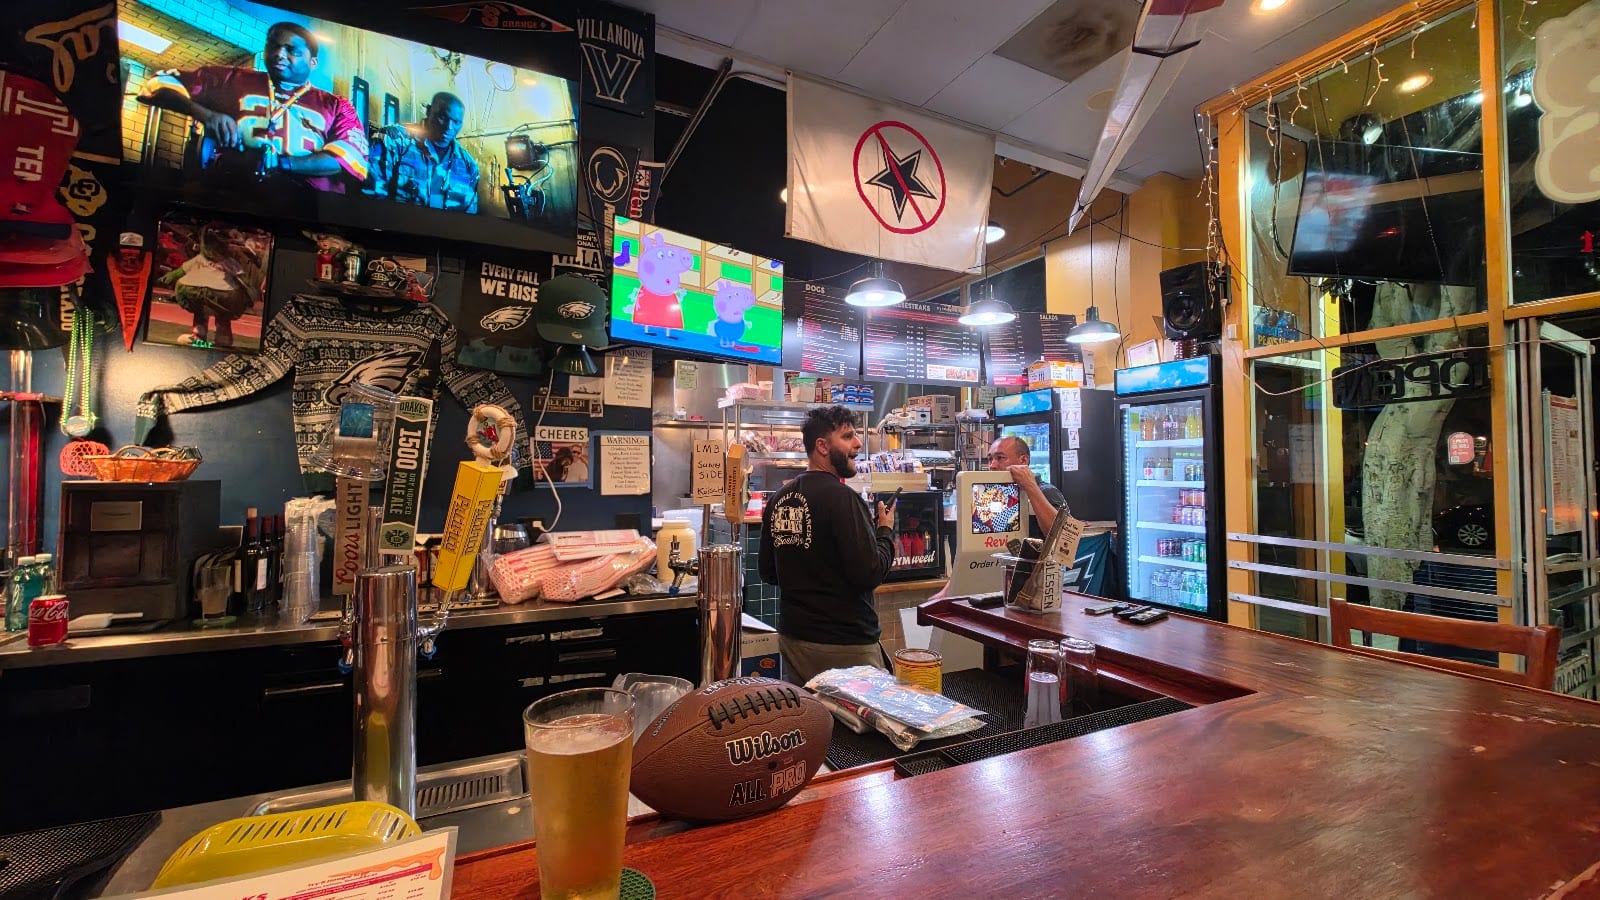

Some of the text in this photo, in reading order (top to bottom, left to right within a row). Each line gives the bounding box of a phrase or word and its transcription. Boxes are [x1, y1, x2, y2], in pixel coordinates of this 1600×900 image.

[502, 20, 537, 29] ORANGE
[577, 18, 645, 59] VILLANOVA
[580, 42, 641, 103] V
[480, 277, 539, 303] WE RISE
[481, 262, 540, 286] EVERY FALL
[805, 283, 825, 294] DOGS
[319, 348, 350, 359] EAGLES
[396, 428, 421, 470] 1500
[540, 428, 585, 441] CHEERS
[346, 483, 363, 530] LIGHT
[389, 471, 407, 515] PALE ALE
[336, 533, 361, 585] Coors
[969, 560, 993, 570] Order
[725, 728, 806, 766] Wilson
[729, 760, 807, 807] ALL PRO
